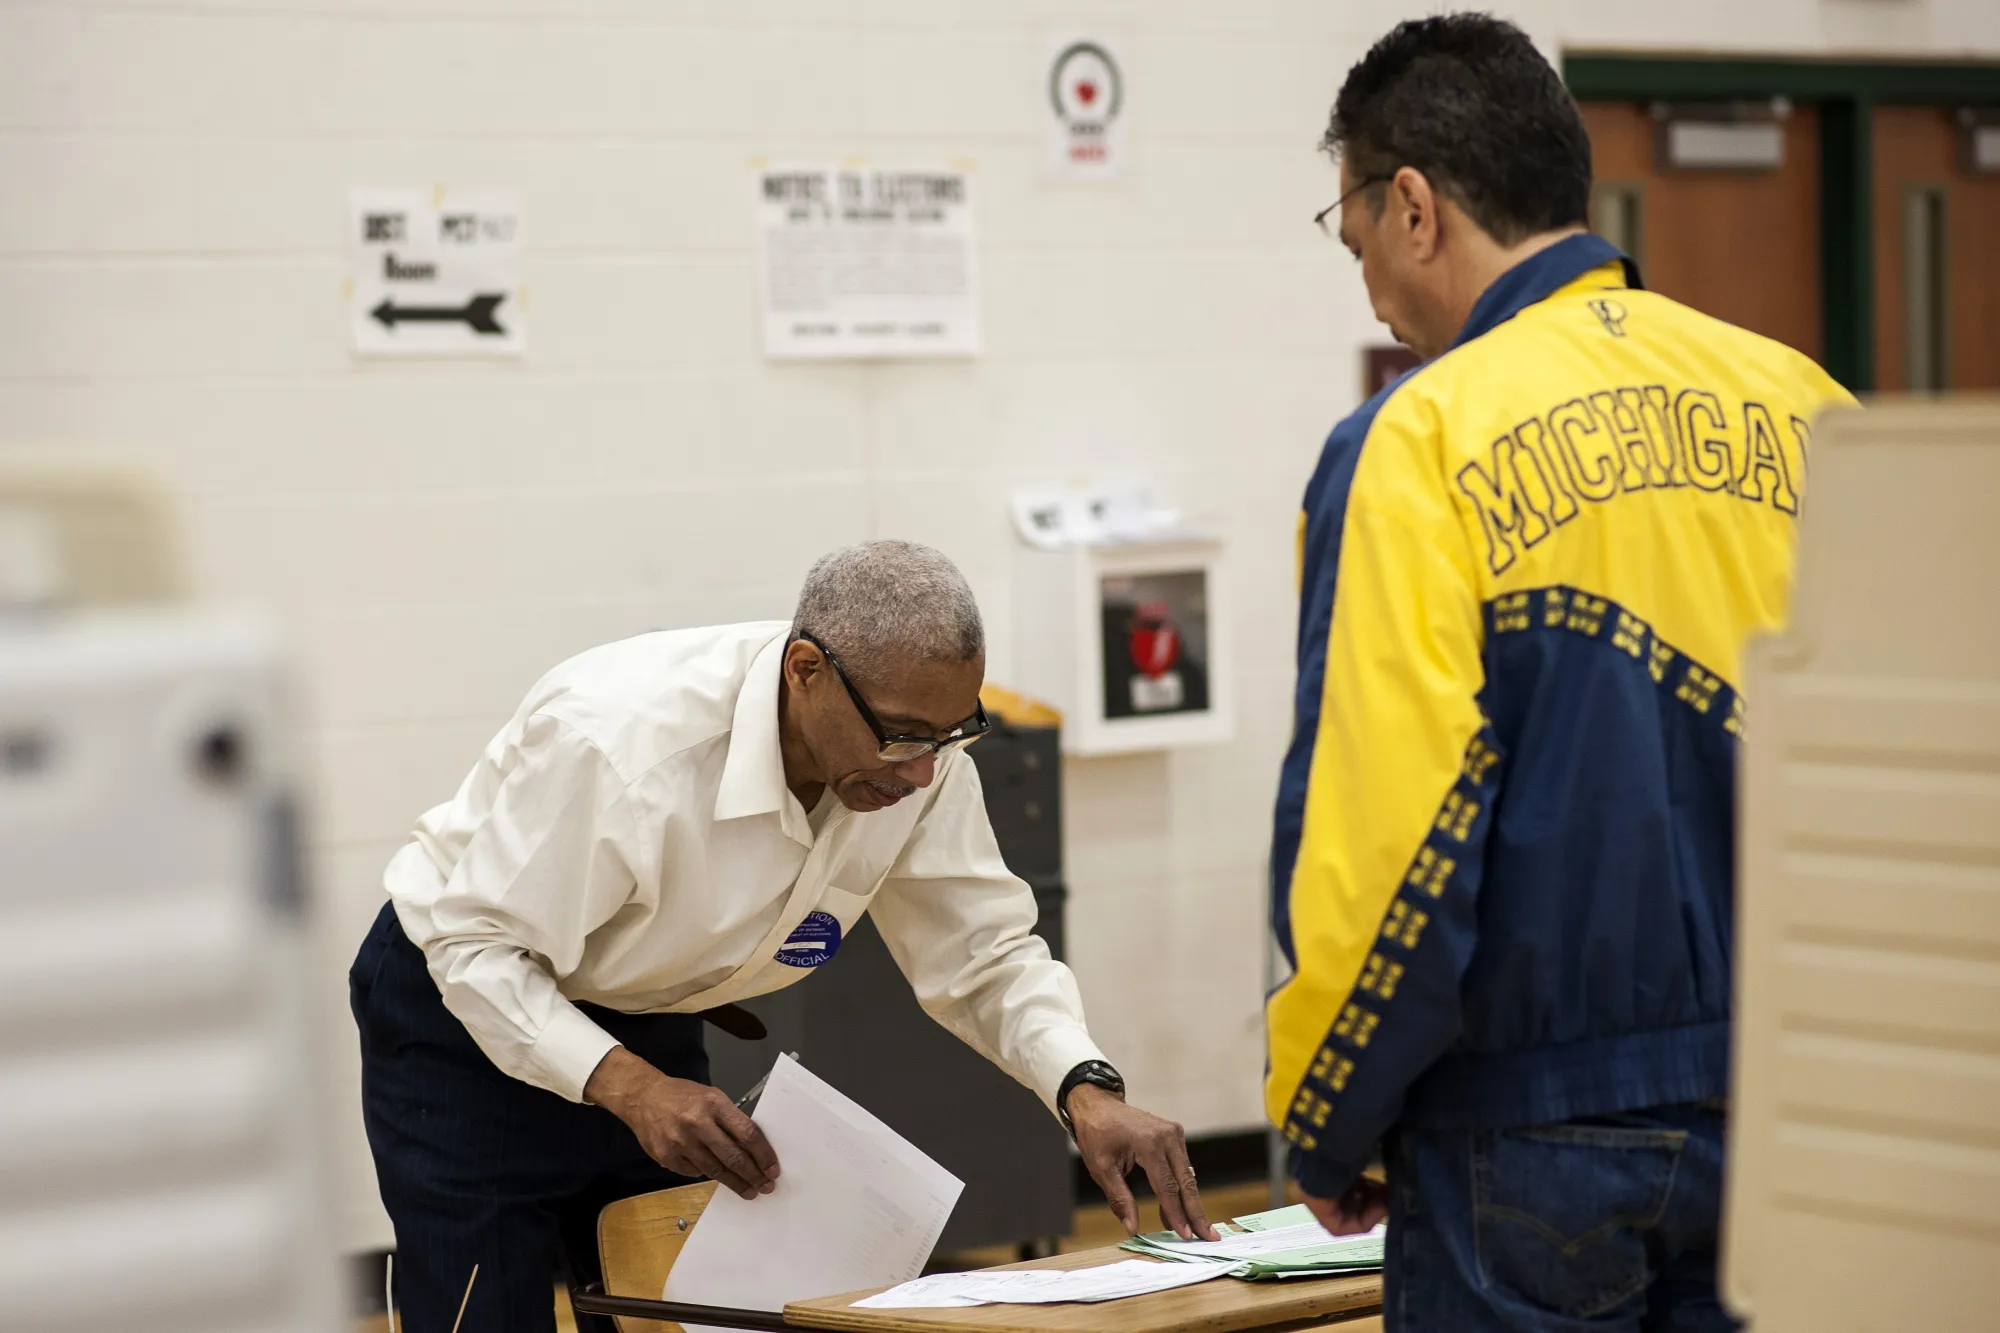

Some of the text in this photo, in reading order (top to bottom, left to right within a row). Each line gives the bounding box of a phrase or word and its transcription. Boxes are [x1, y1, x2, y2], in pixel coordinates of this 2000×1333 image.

[1456, 385, 1812, 576] MICHIGA
[810, 912, 835, 925] TION
[775, 952, 830, 966] OFFICIAL
